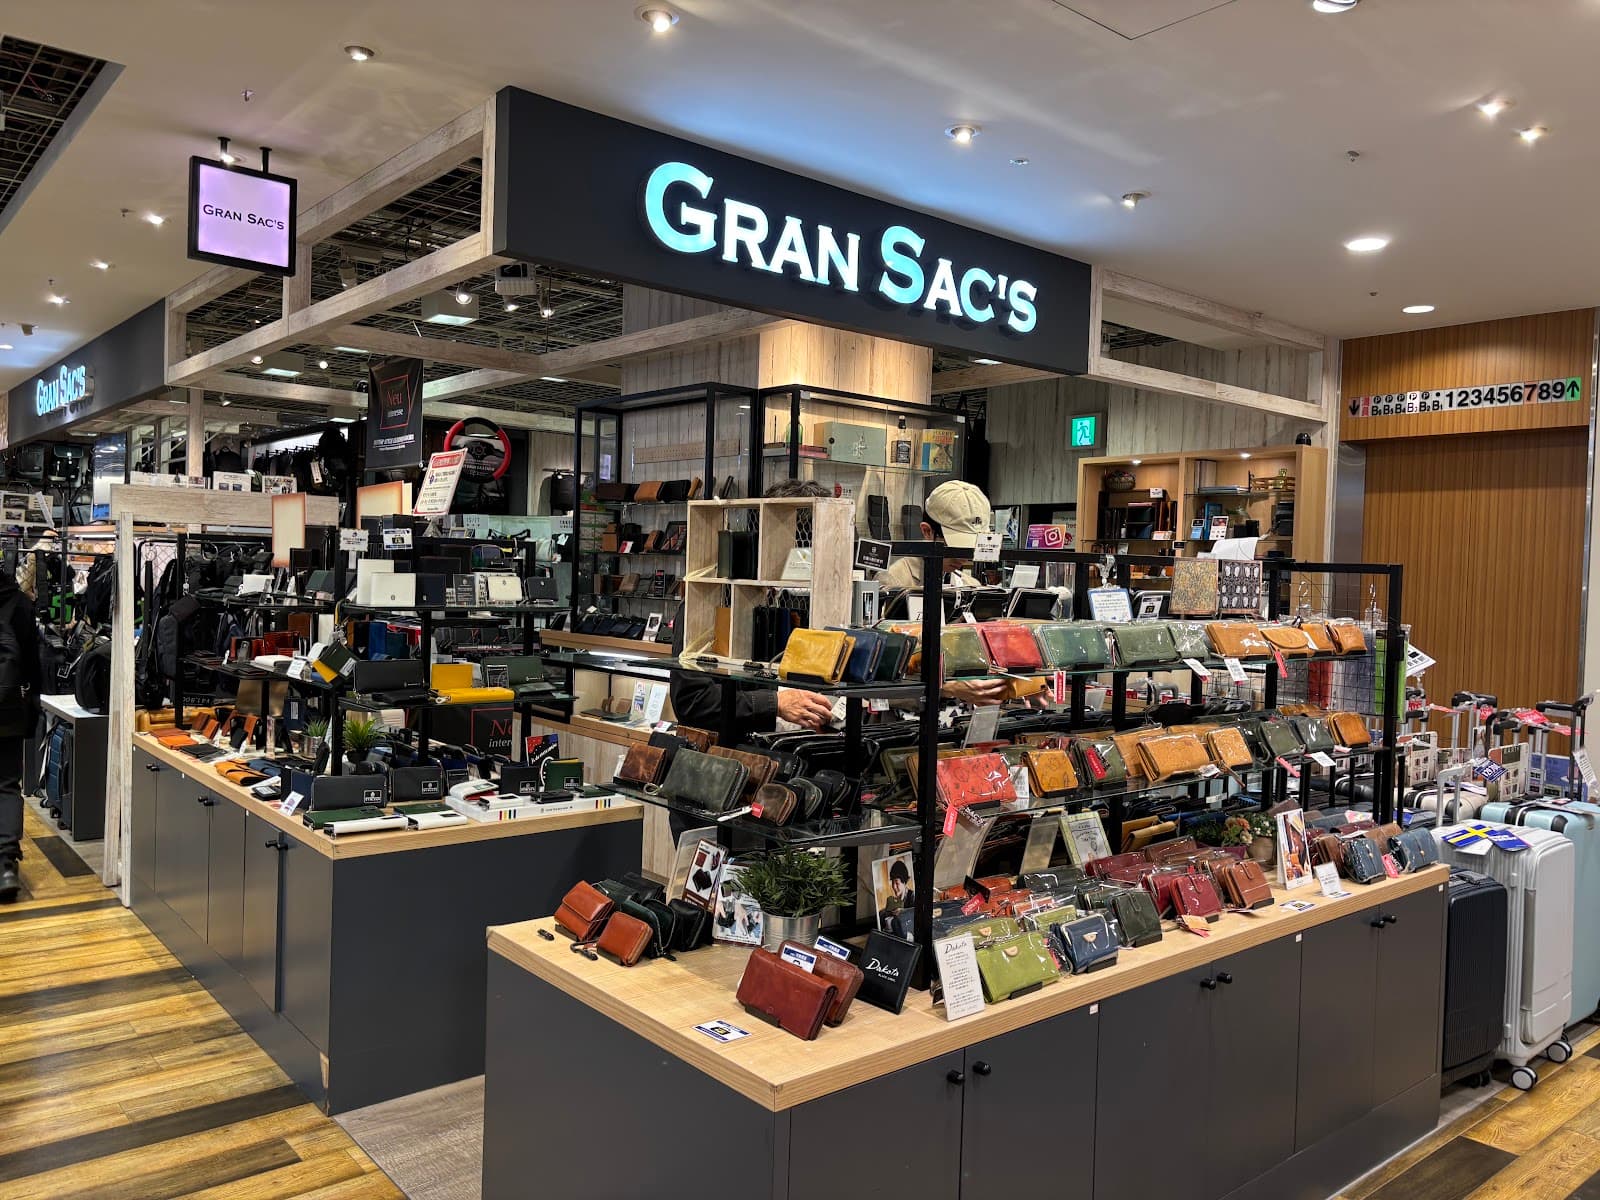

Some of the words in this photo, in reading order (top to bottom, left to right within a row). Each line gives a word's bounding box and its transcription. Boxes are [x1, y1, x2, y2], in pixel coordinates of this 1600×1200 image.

[203, 204, 242, 222] GRAN
[247, 213, 285, 230] SAC'S
[644, 161, 861, 292] GRAN
[878, 224, 1038, 334] SAC'S
[36, 378, 59, 417] GRAN
[60, 364, 86, 405] SAC'S
[489, 738, 513, 748] inter
[864, 957, 899, 977] Dakota
